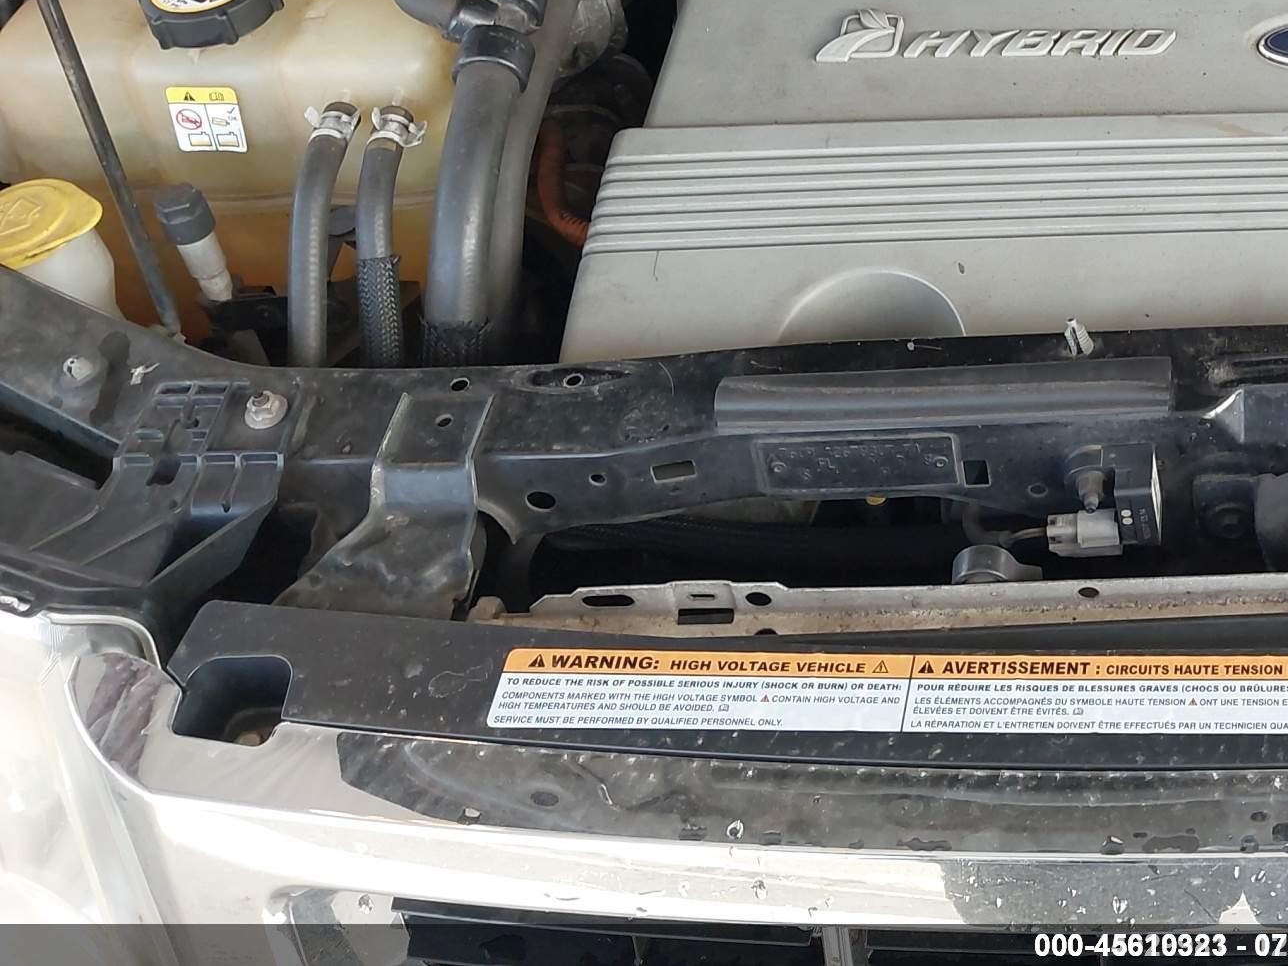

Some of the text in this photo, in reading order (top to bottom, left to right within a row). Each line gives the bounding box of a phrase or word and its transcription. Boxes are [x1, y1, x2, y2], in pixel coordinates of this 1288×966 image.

[903, 29, 1176, 58] HYBRID
[549, 654, 866, 673] WARNING: HIGH VOLTAGE VEHICLE
[942, 662, 1090, 675] AVERTISSEMENT
[1106, 663, 1169, 675] CIRCUITS
[1174, 663, 1219, 676] HAUTE
[1224, 663, 1282, 676] TENSION
[506, 678, 901, 691] TO REDUCE THE RISK OF POSSIBLE SERIOUS INJURY (SHOCK OR BURN) OR DEATH:
[916, 683, 944, 692] POUR
[947, 683, 991, 692] RÉDUIRE
[993, 684, 1012, 692] LES
[1015, 684, 1059, 692] RISQUES
[1061, 684, 1075, 692] DE
[1077, 684, 1136, 692] BLESSURES
[1138, 684, 1178, 693] GRAVES
[1181, 684, 1219, 693] (CHOCS
[1221, 684, 1236, 693] OU
[501, 691, 900, 704] COMPONENTS MARKED WITH THE HIGH VOLTAGE SYMBOL CONTAIN HIGH VOLTAGE AND
[497, 701, 715, 712] HIGH TEMPERATURES AND SHOULD BE AVOIDED.
[493, 716, 783, 727] SERVICE MUST BE PERFORMED BY QUALIFIED PERSONNEL ONLY.
